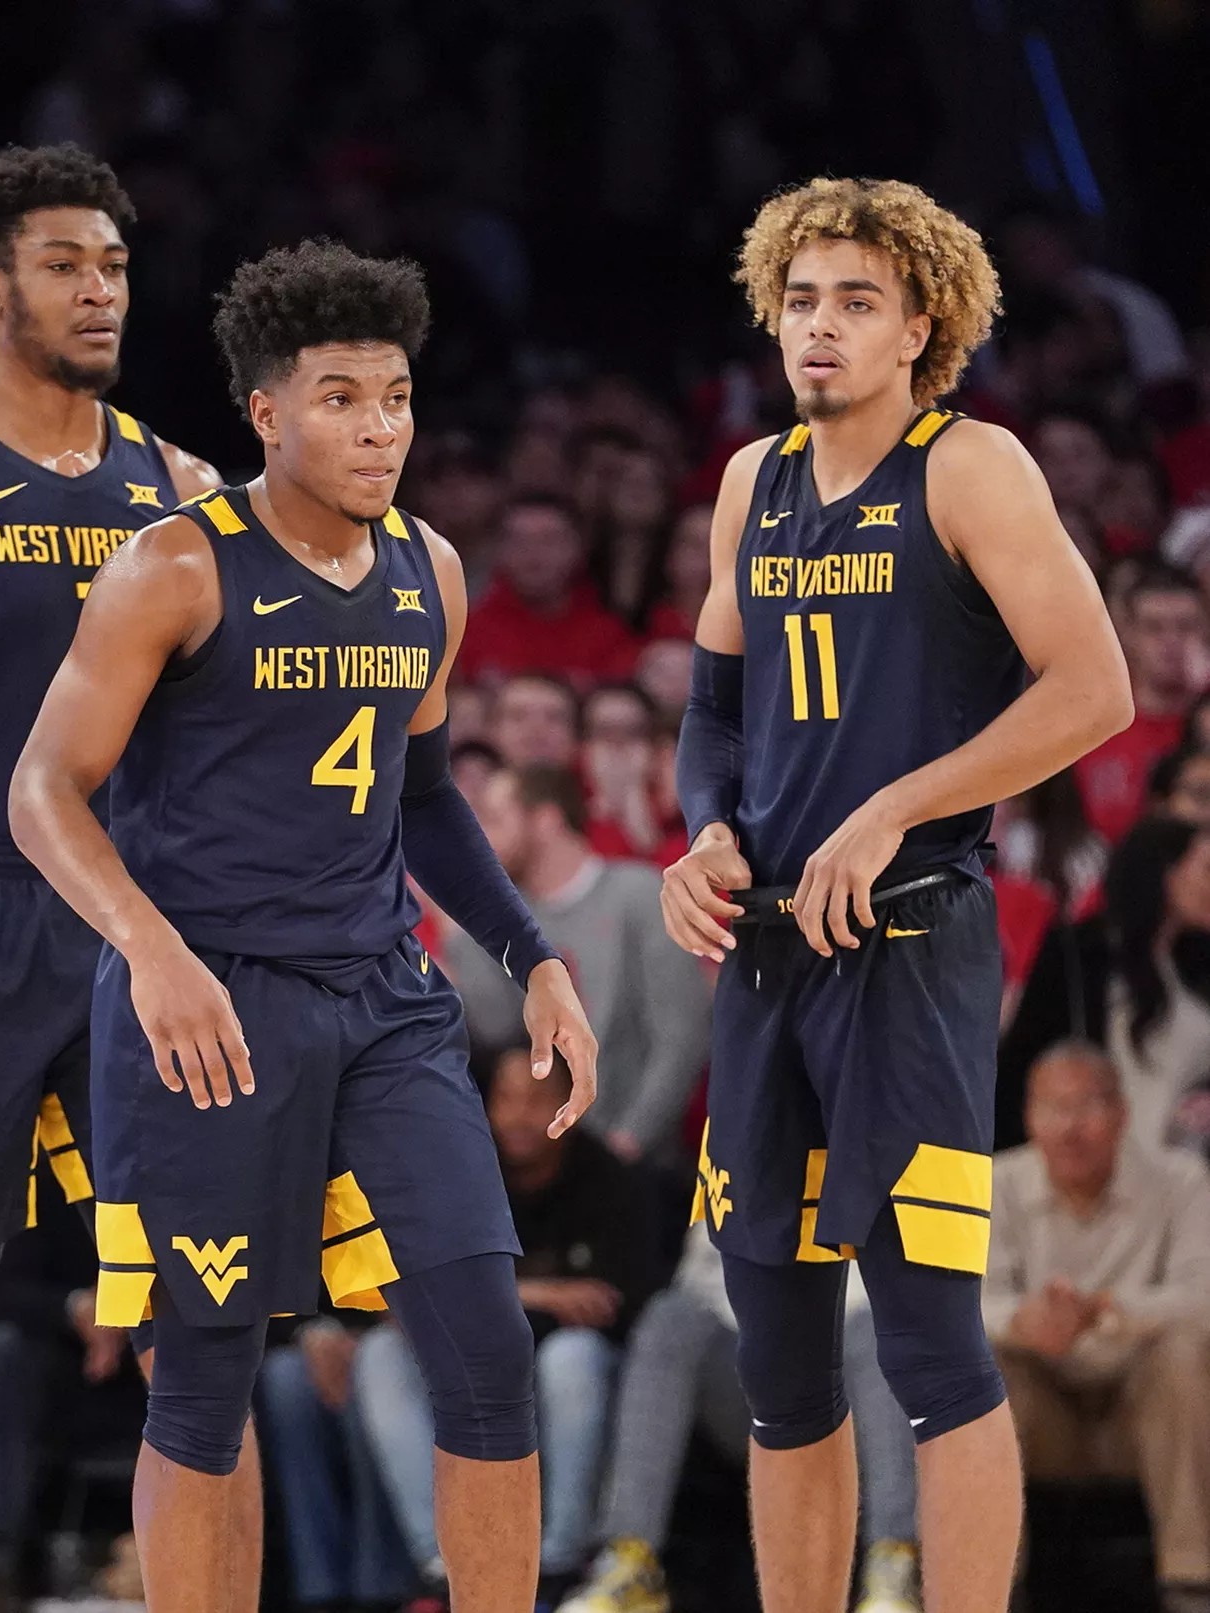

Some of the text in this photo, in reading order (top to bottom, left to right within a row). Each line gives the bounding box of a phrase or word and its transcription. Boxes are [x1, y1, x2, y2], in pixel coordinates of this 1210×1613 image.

[63, 526, 136, 567] VIR
[254, 645, 430, 690] WEST VIRGINIA
[784, 613, 840, 721] 11
[310, 705, 377, 815] 4
